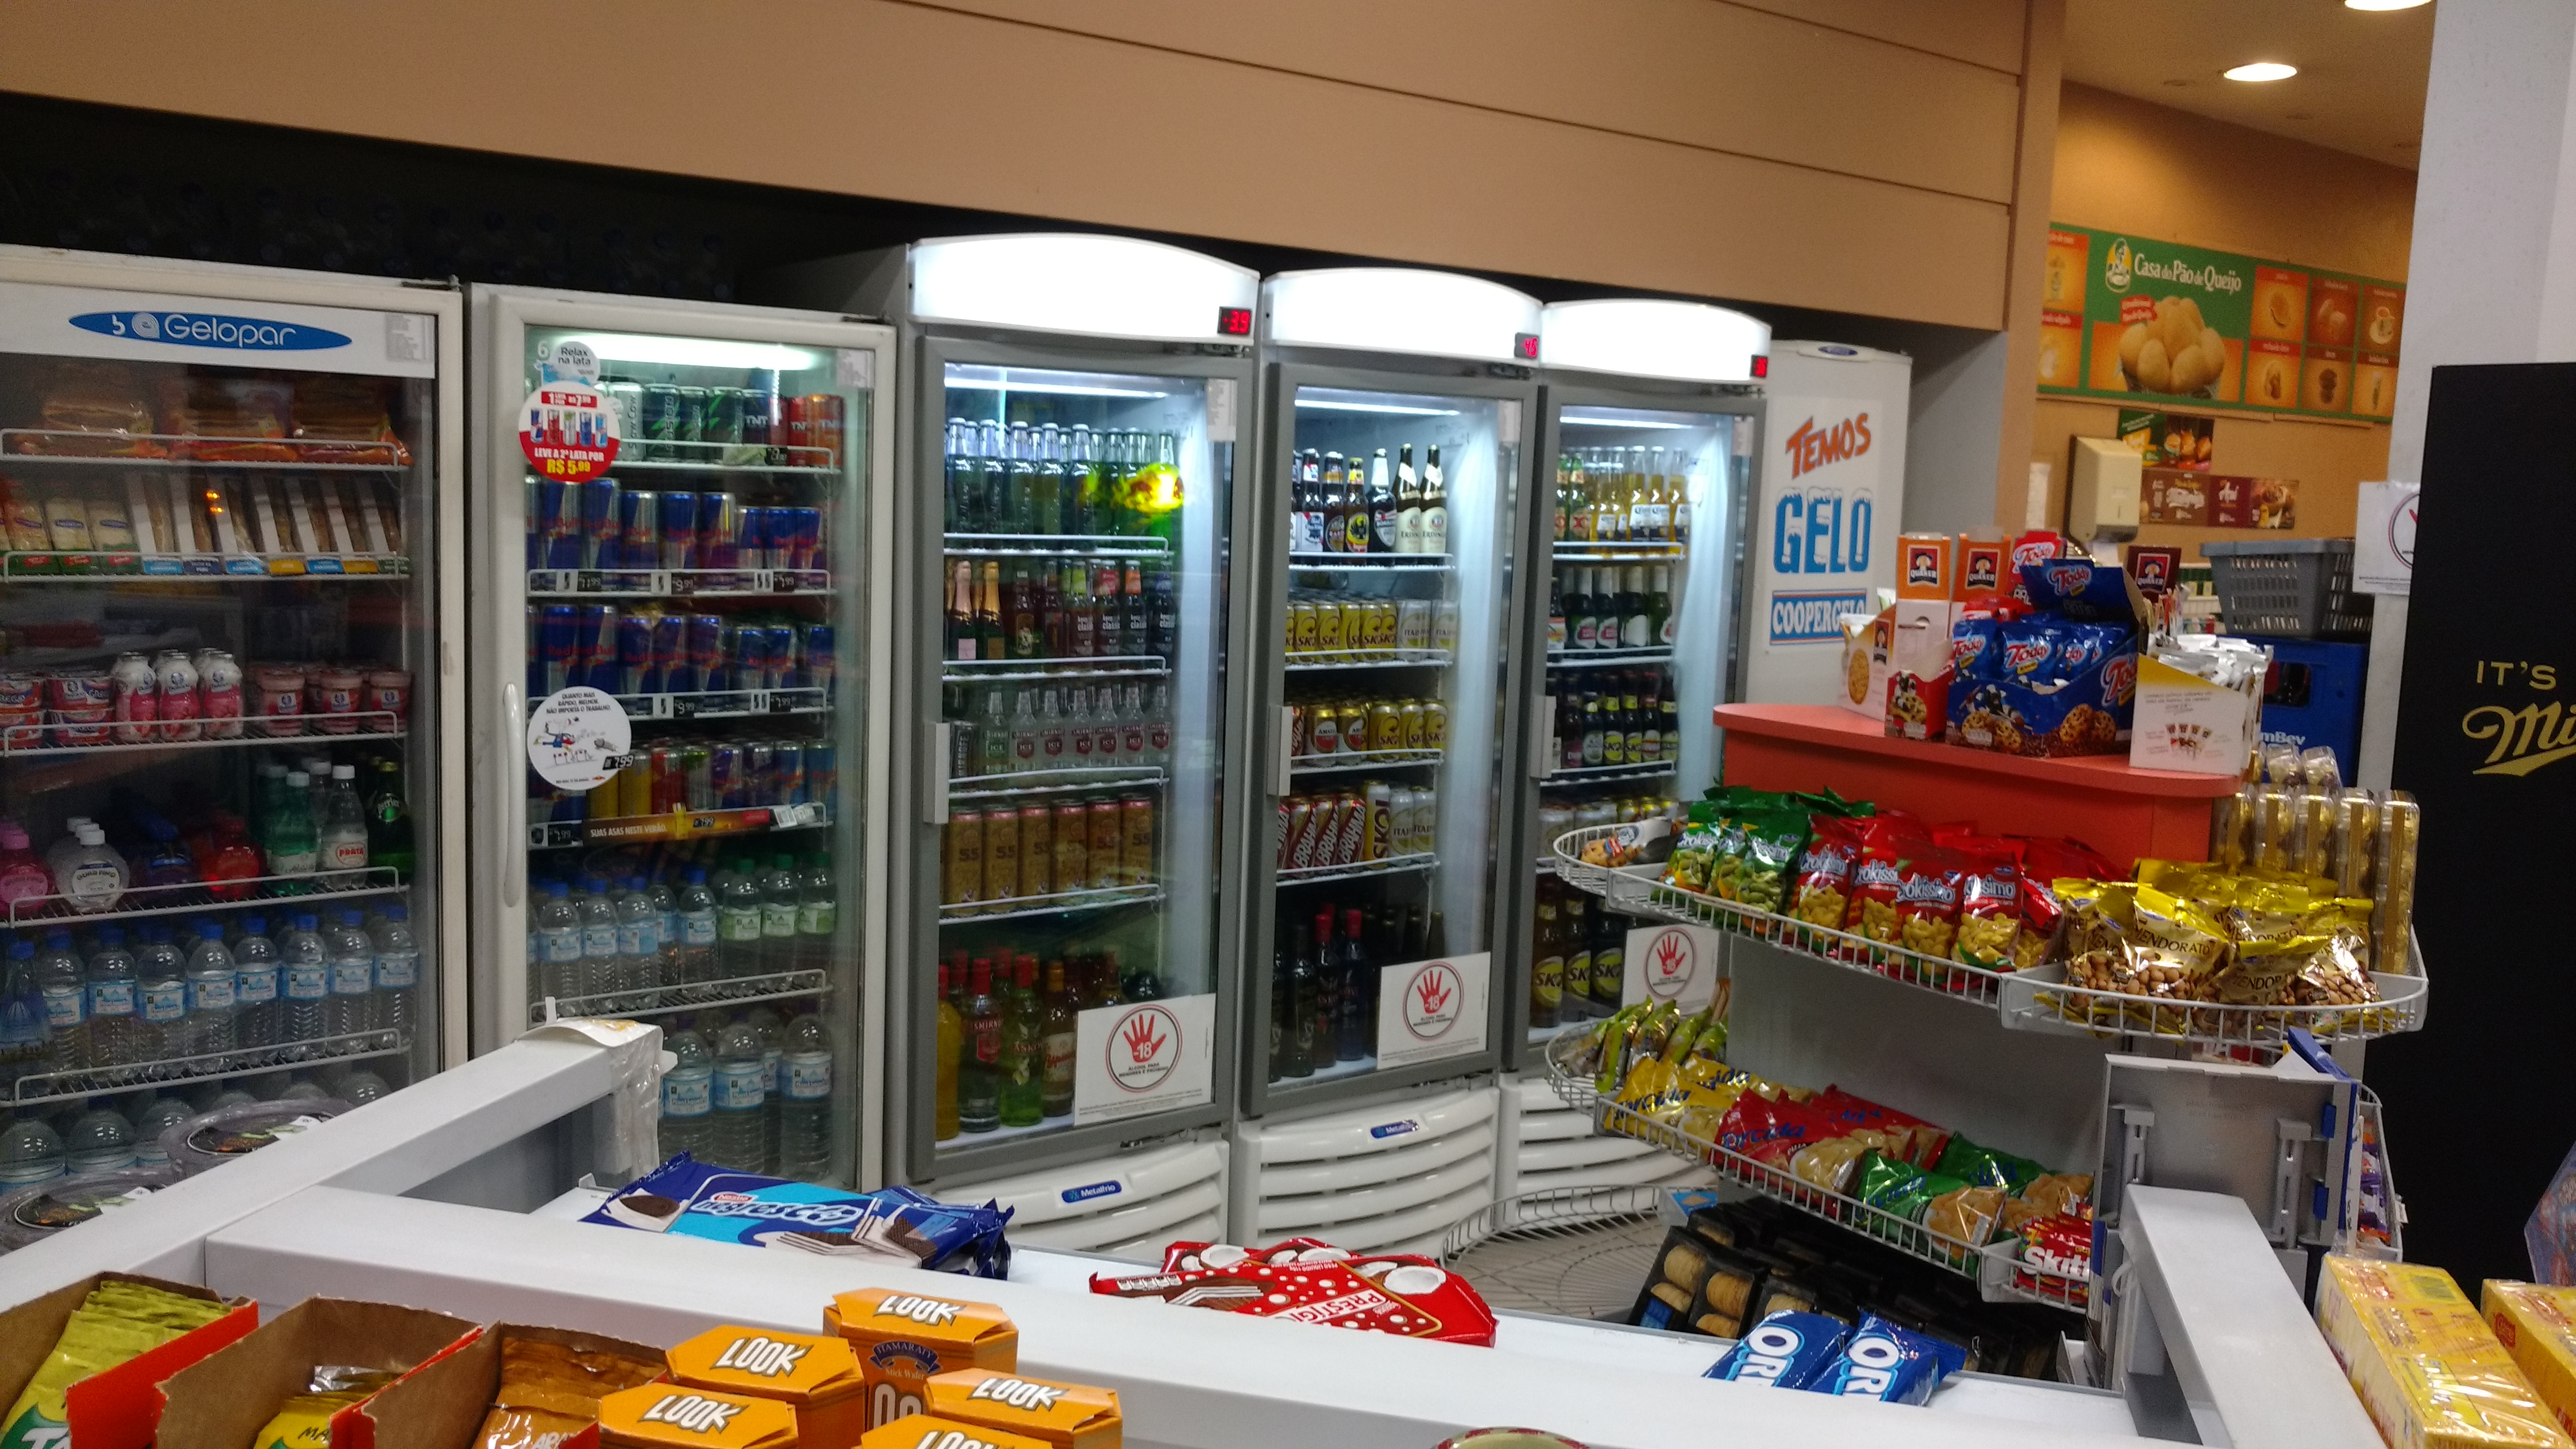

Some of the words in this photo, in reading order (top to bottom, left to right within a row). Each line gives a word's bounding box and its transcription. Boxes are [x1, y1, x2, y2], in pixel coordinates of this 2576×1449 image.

[2134, 253, 2160, 278] Casa
[2173, 260, 2194, 284] Pão
[2204, 266, 2241, 295] Queijo
[164, 313, 296, 348] Gelopar
[561, 347, 588, 356] Relax
[573, 356, 591, 365] lata
[745, 415, 769, 425] TNT
[535, 447, 552, 458] LEVE
[553, 449, 559, 458] A
[570, 449, 588, 461] LATA
[1785, 413, 1871, 479] TEMOS
[547, 458, 565, 475] R$
[1773, 486, 1873, 574] GELO
[1910, 569, 1936, 578] QUAKER
[1969, 573, 1995, 582] QUAKER
[2005, 643, 2050, 668] Toddy
[2066, 644, 2085, 662] ddy
[2476, 660, 2556, 691] IT'S
[2261, 731, 2306, 746] mBev
[2462, 700, 2576, 765] Mi
[590, 828, 607, 838] SUAS
[608, 826, 624, 836] ASAS
[1425, 994, 1440, 1011] -18
[973, 1020, 1000, 1031] SMIRN
[1134, 1041, 1152, 1060] -18
[1080, 1183, 1116, 1197] Metalfrio
[2023, 1246, 2091, 1282] Skitt
[873, 1294, 966, 1327] LOOK
[711, 1335, 813, 1377] LOOK
[1734, 1325, 1799, 1387] OR
[1841, 1336, 1901, 1401] OR
[967, 1377, 1068, 1410] LOOK
[639, 1395, 750, 1434] LOOK
[22, 1427, 69, 1449] TA
